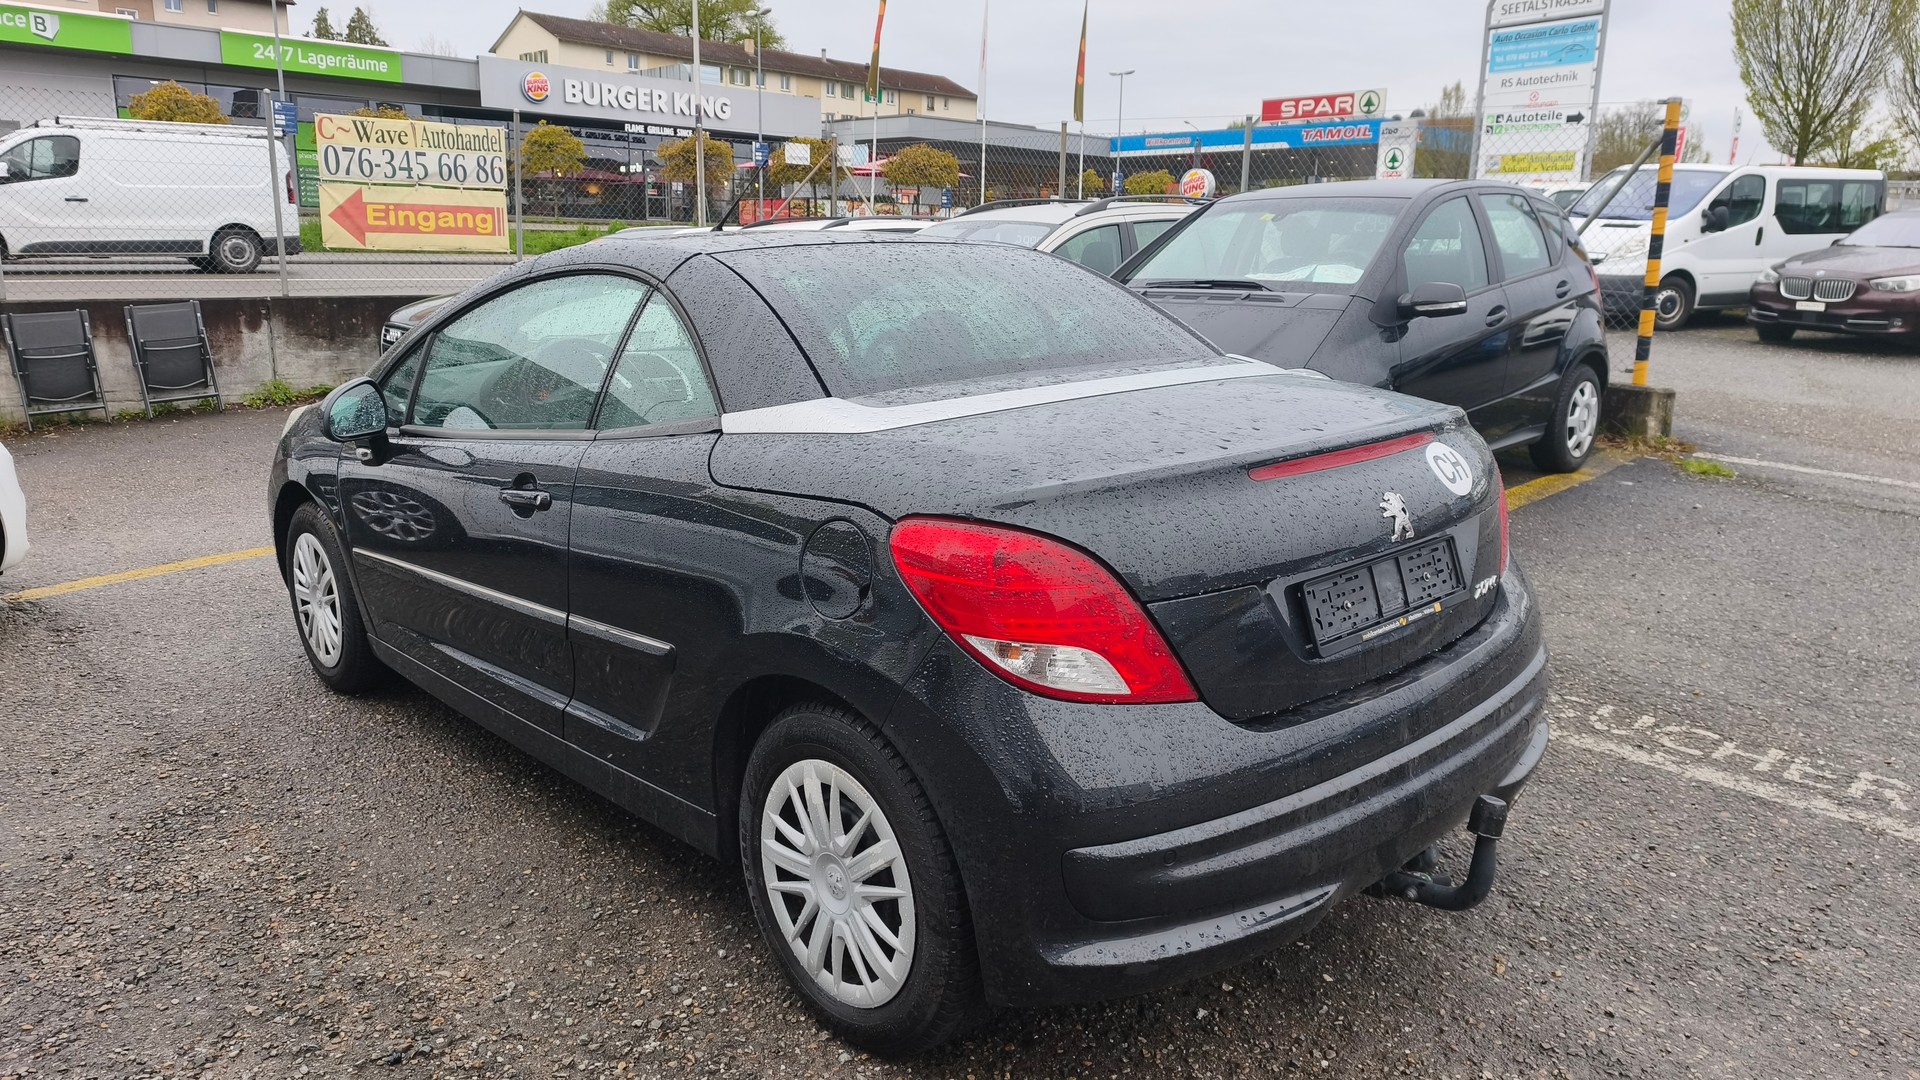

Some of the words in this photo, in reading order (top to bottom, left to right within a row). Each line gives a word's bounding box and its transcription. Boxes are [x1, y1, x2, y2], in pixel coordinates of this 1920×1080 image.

[1501, 0, 1593, 16] SEETALSTRA
[0, 12, 27, 28] ce
[33, 15, 47, 32] B
[1495, 34, 1513, 43] Auto
[1514, 30, 1547, 41] Occasion
[1548, 26, 1569, 37] Carlo
[1570, 22, 1595, 33] GmbH
[298, 47, 388, 73] Lagerräume
[527, 84, 549, 93] KING
[1501, 78, 1513, 88] RS
[1516, 71, 1579, 87] Autotechnik
[564, 78, 668, 114] BURGER
[673, 91, 731, 120] KING
[1280, 95, 1354, 118] SPAR
[1506, 110, 1563, 123] Autoteile
[420, 125, 503, 152] Autohandel
[624, 123, 645, 133] FLAME
[647, 125, 675, 136] GRILLING
[1302, 124, 1372, 142] TAMOIL
[323, 144, 429, 181] 076-345
[438, 152, 468, 183] 66
[476, 154, 504, 184] 86
[1541, 162, 1574, 172] Verkauf
[1183, 182, 1206, 196] KING
[366, 204, 494, 234] Eingang
[1432, 451, 1469, 485] CH
